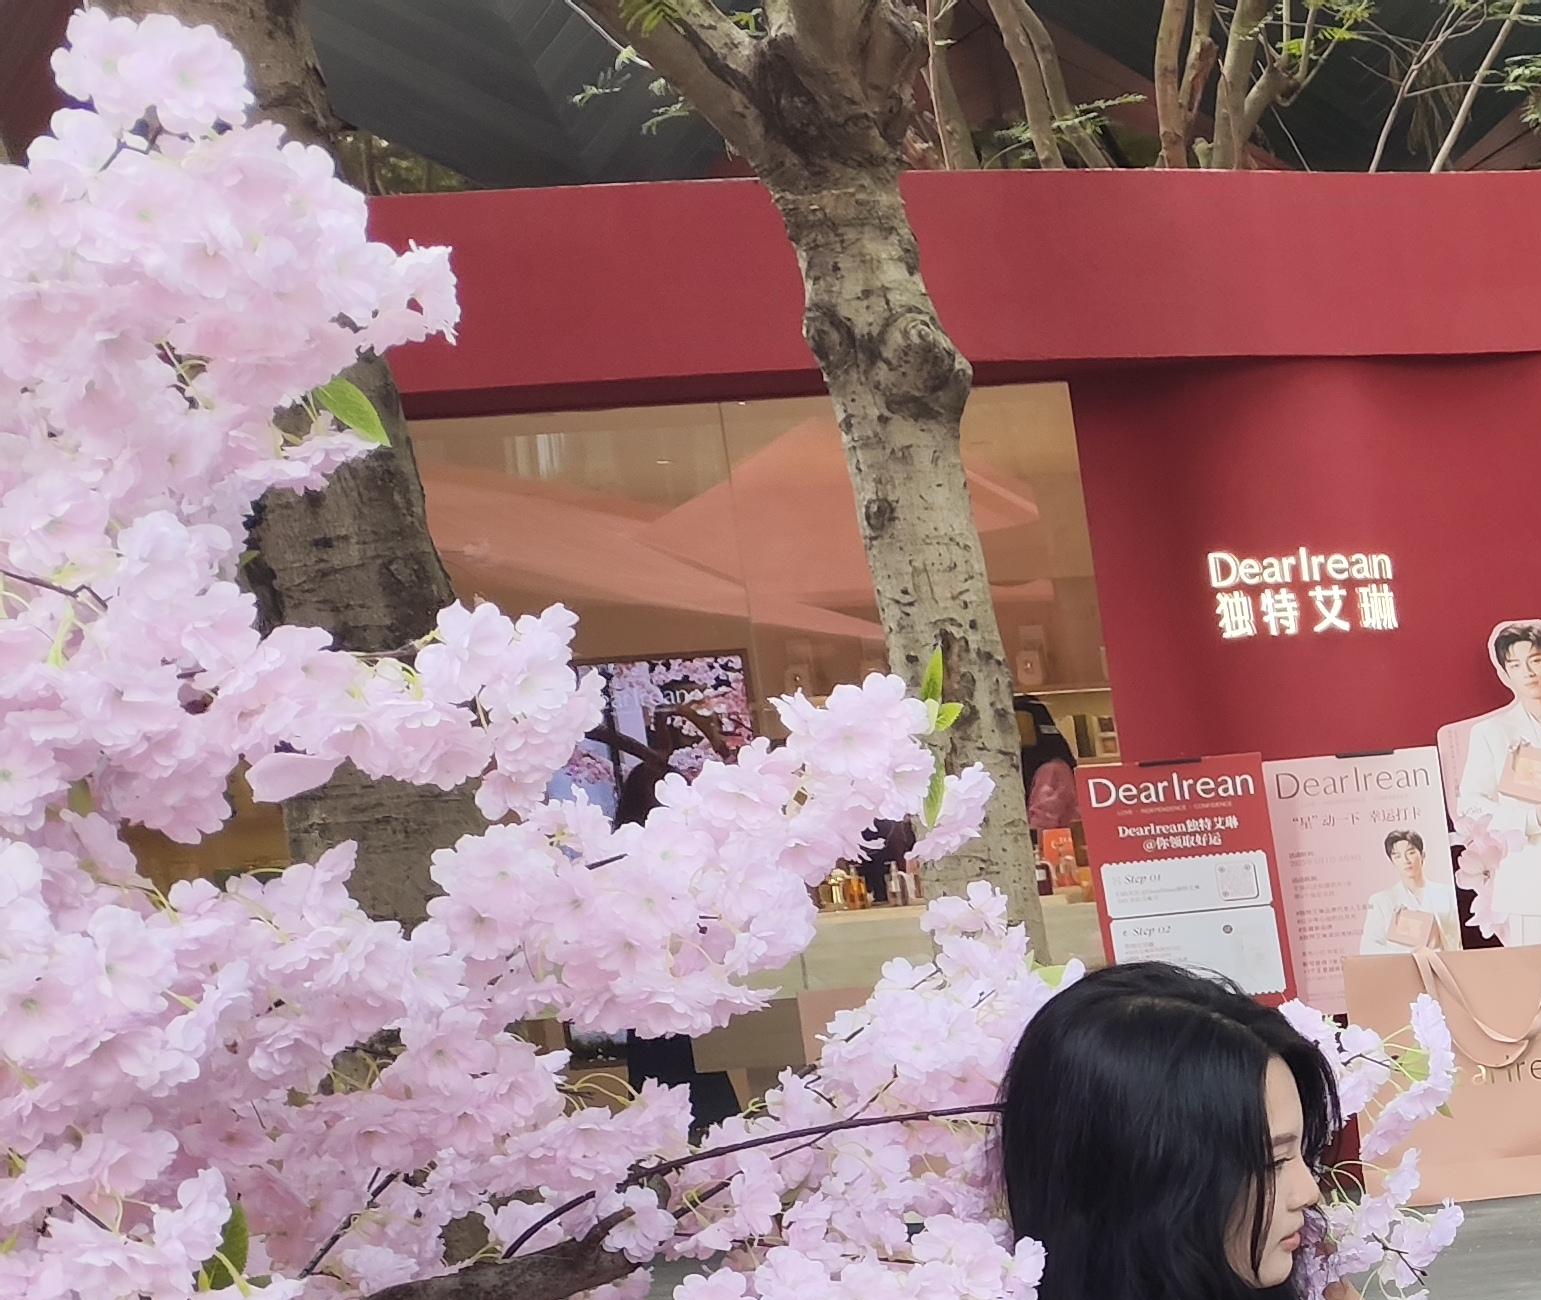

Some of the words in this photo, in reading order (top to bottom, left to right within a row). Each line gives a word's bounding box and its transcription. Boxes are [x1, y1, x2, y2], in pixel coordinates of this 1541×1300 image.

[1207, 546, 1394, 588] DearIrean
[1215, 583, 1400, 639] 独特艾琳
[1088, 772, 1255, 808] DearIrean
[1275, 766, 1430, 800] DearIrean
